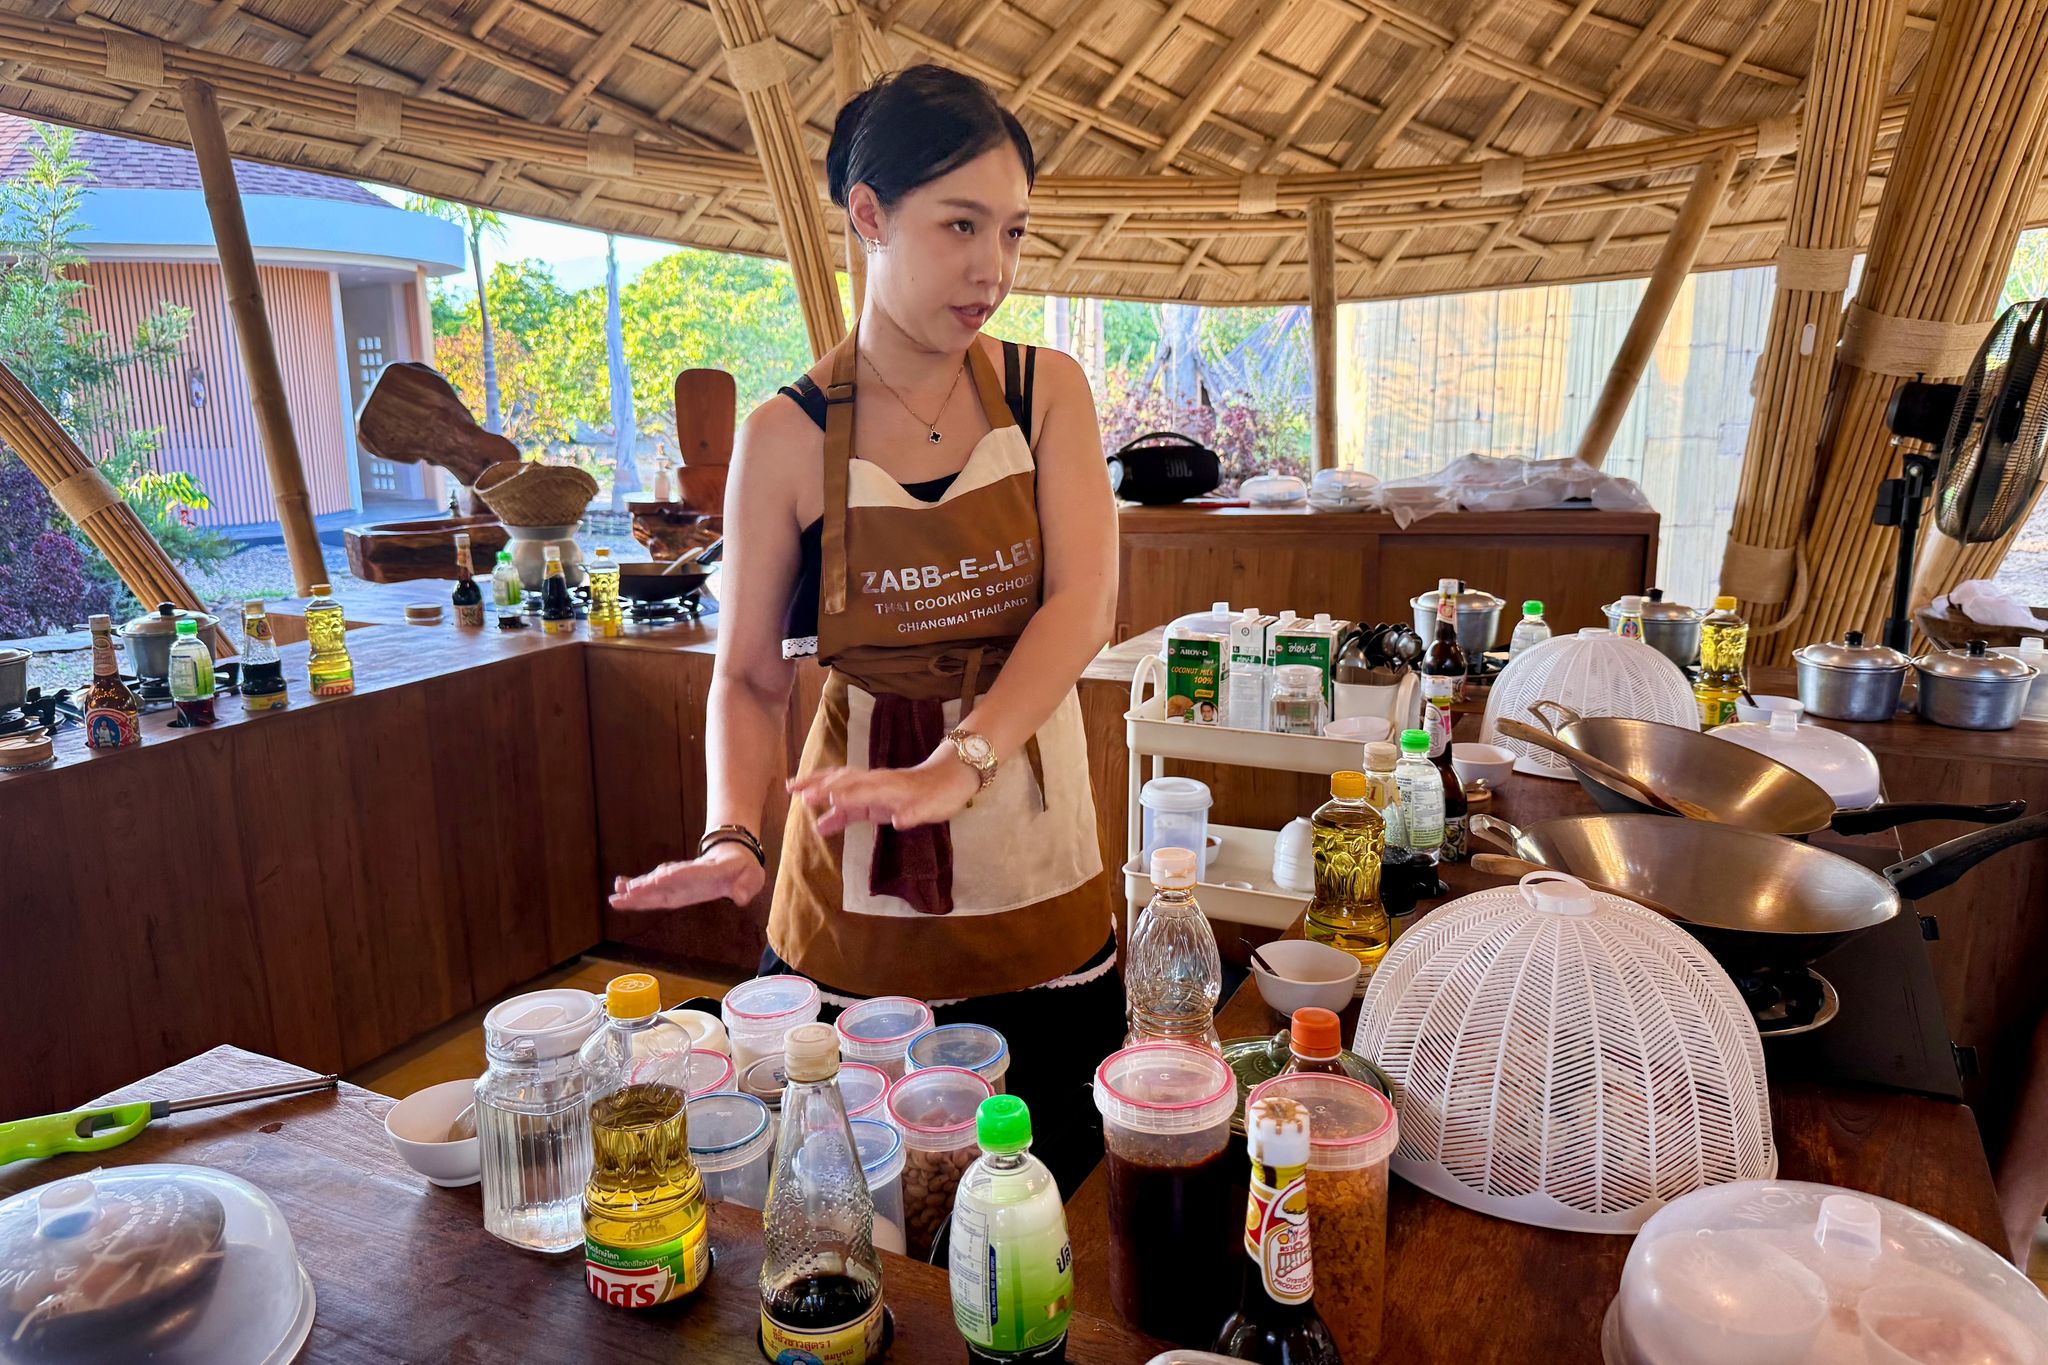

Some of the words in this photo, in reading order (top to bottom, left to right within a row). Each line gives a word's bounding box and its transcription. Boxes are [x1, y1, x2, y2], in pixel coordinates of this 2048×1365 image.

[1166, 459, 1193, 478] JBL
[875, 601, 910, 615] THAI
[914, 587, 982, 611] COOKING
[986, 574, 1034, 596] SCHOO
[969, 597, 1028, 620] THAILAND
[1179, 648, 1209, 656] AROY-D
[1171, 666, 1198, 675] COCONUT
[1200, 668, 1214, 676] MILK
[1194, 676, 1214, 685] 100%
[1056, 1241, 1072, 1274] ปล
